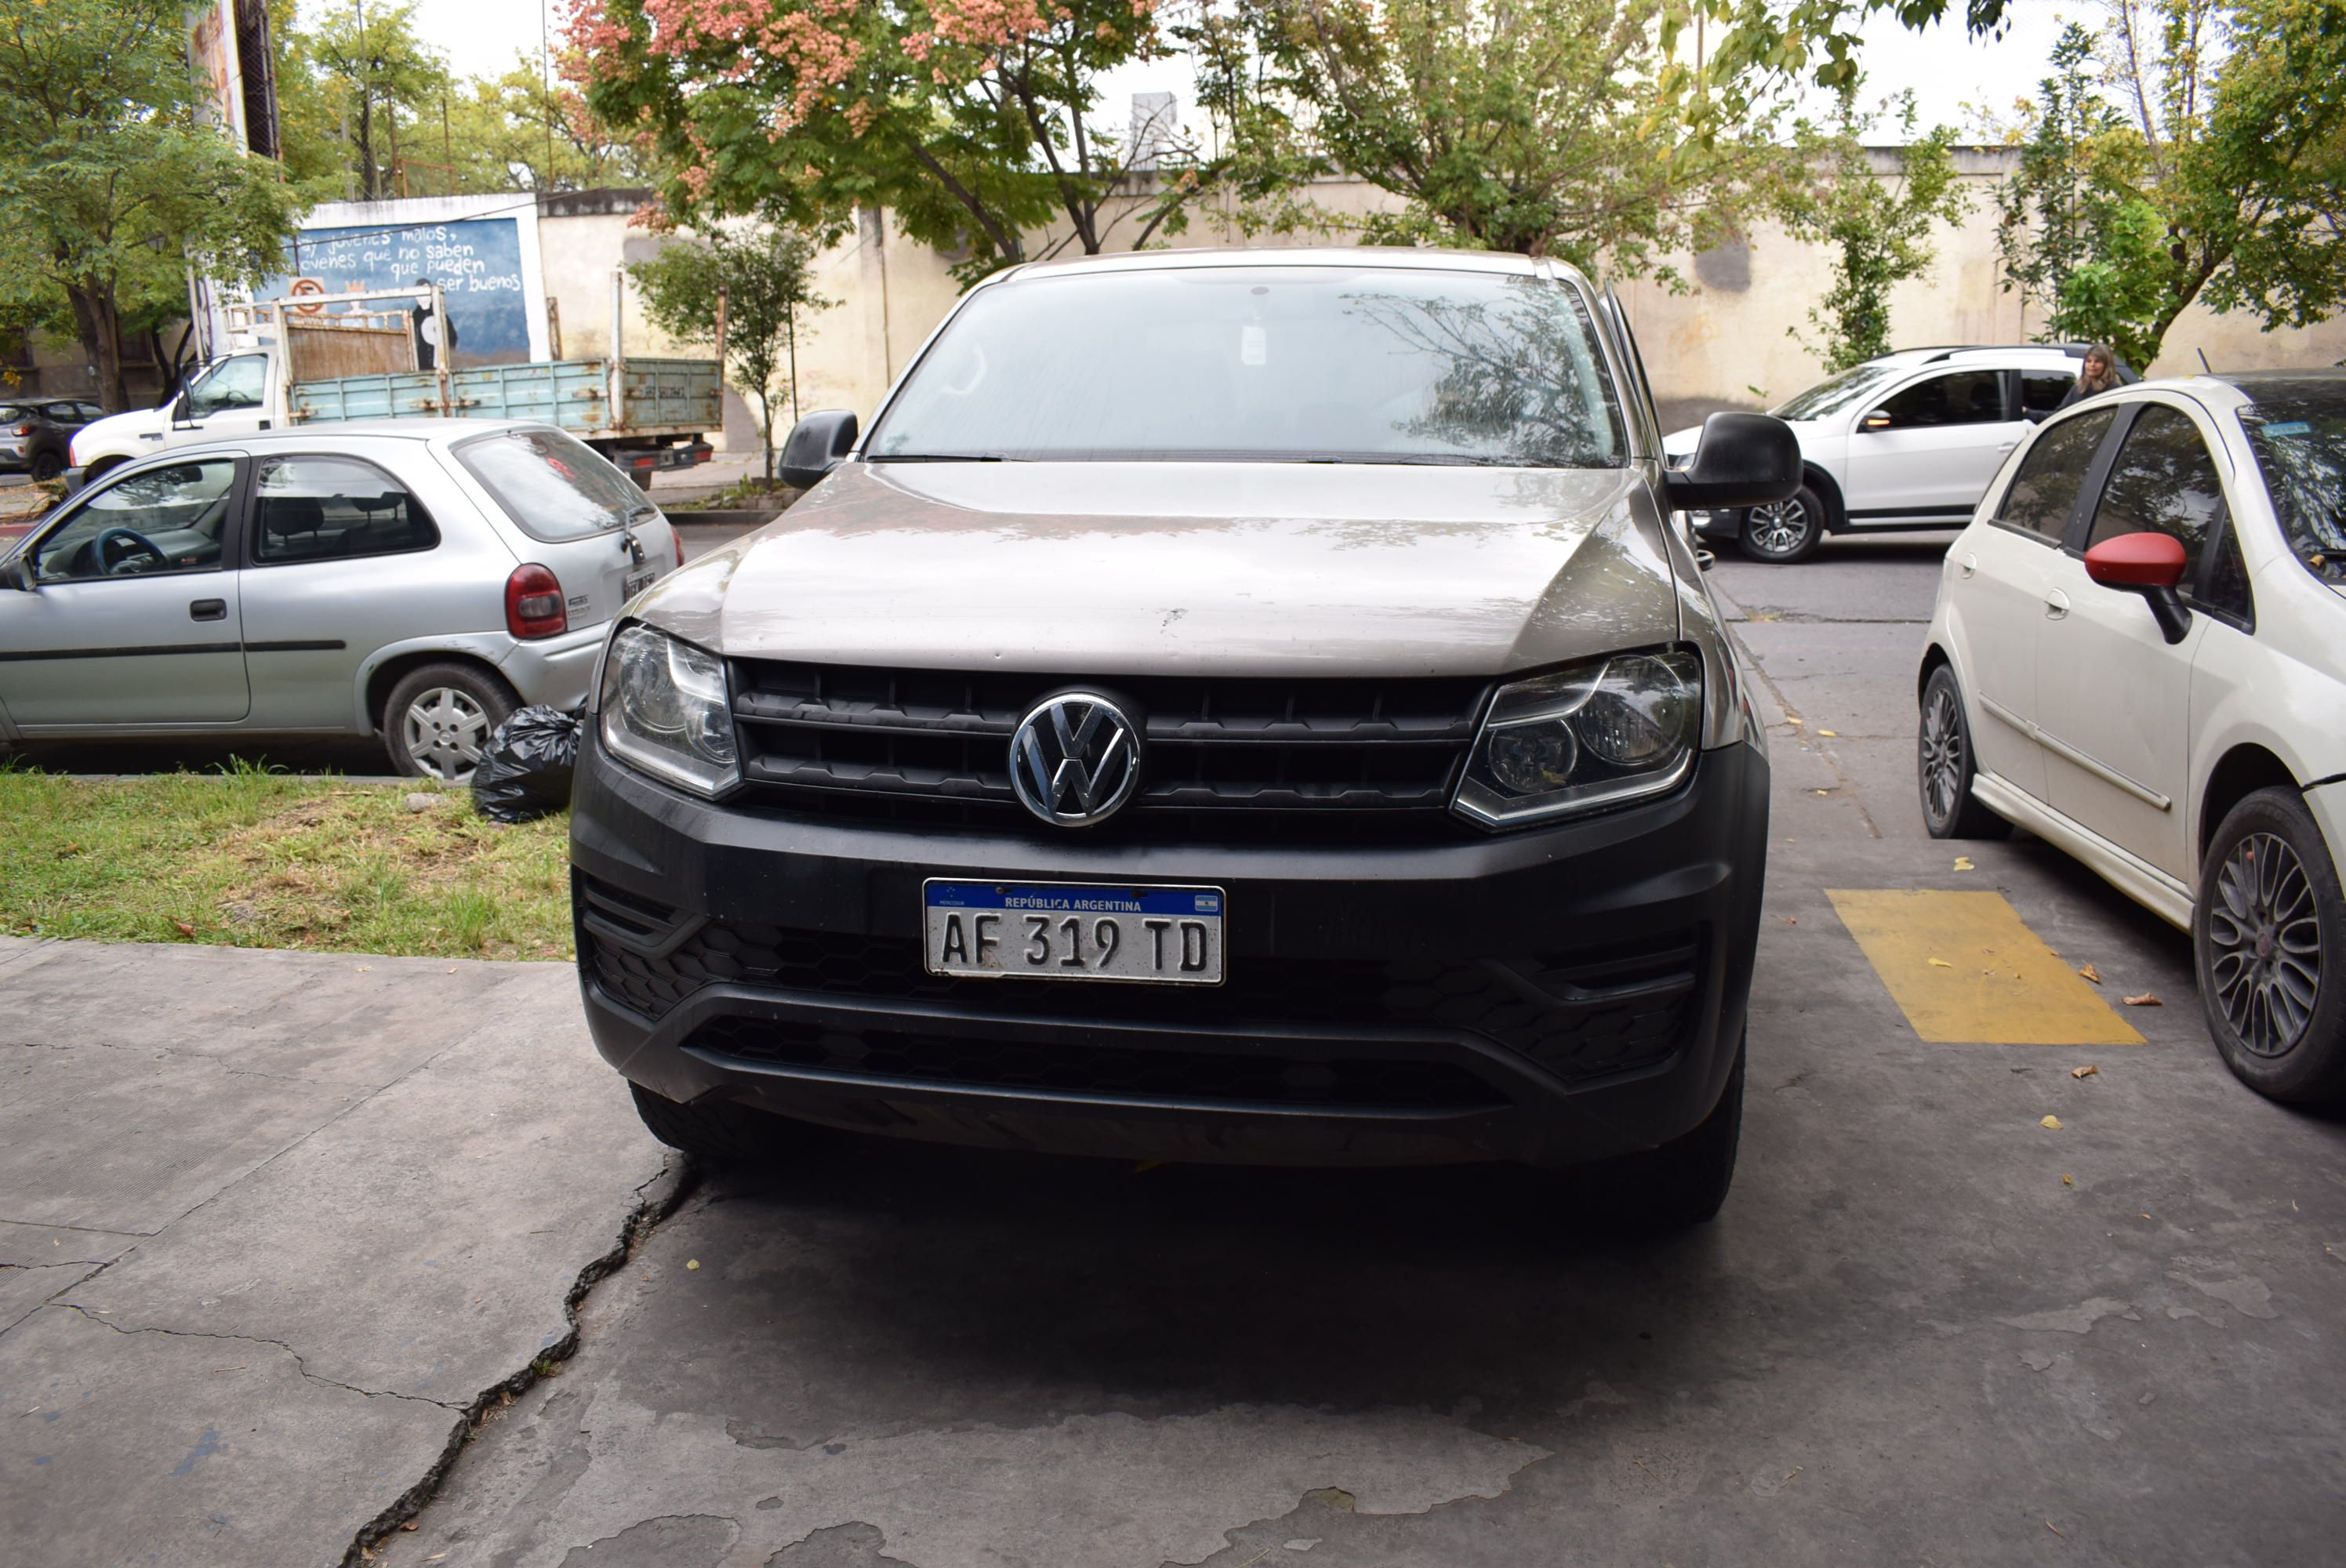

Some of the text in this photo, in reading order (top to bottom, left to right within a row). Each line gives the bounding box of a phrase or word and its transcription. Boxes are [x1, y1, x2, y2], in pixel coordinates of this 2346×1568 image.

[328, 230, 390, 255] jóvenes
[401, 226, 457, 243] malos,
[300, 254, 356, 271] óvenes
[364, 250, 391, 272] que
[398, 247, 419, 260] no
[426, 242, 474, 260] saben
[390, 258, 485, 282] que pueden
[437, 273, 521, 292] ser buenos
[1004, 896, 1142, 912] REPÚBLICA ARGENTINA
[942, 912, 1208, 972] AF 319 TD
